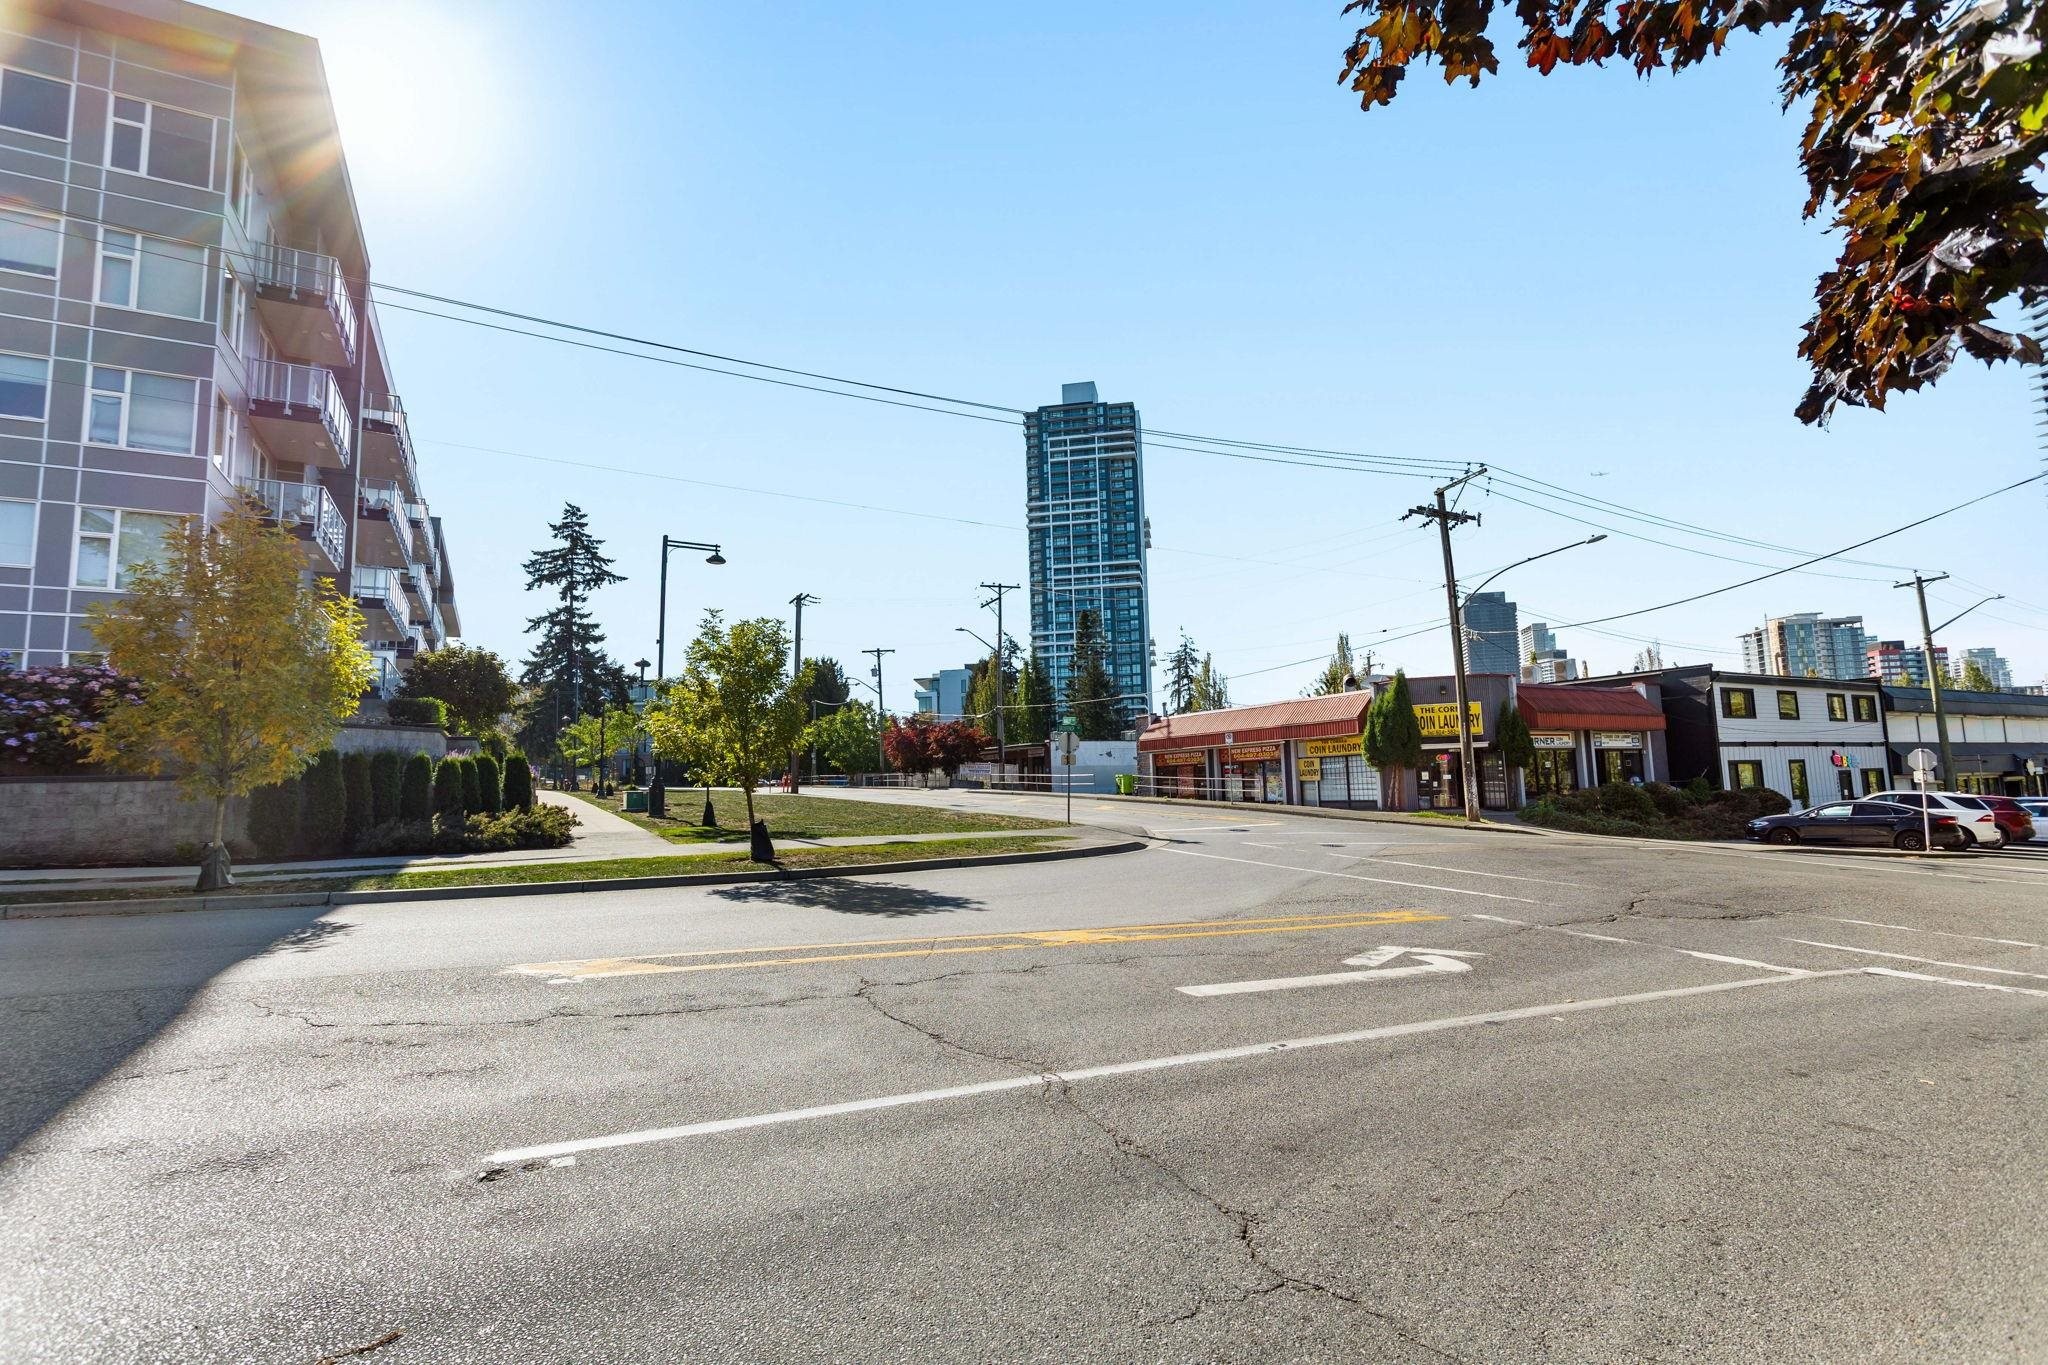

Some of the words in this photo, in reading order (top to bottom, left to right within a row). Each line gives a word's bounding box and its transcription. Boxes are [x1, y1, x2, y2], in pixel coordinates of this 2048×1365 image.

[1438, 705, 1471, 713] CORR
[1534, 737, 1555, 745] RNER
[1309, 745, 1327, 755] COIN
[1328, 743, 1361, 753] LAUNDRY
[1303, 760, 1315, 768] COIN
[1299, 769, 1319, 777] LAUNDRY
